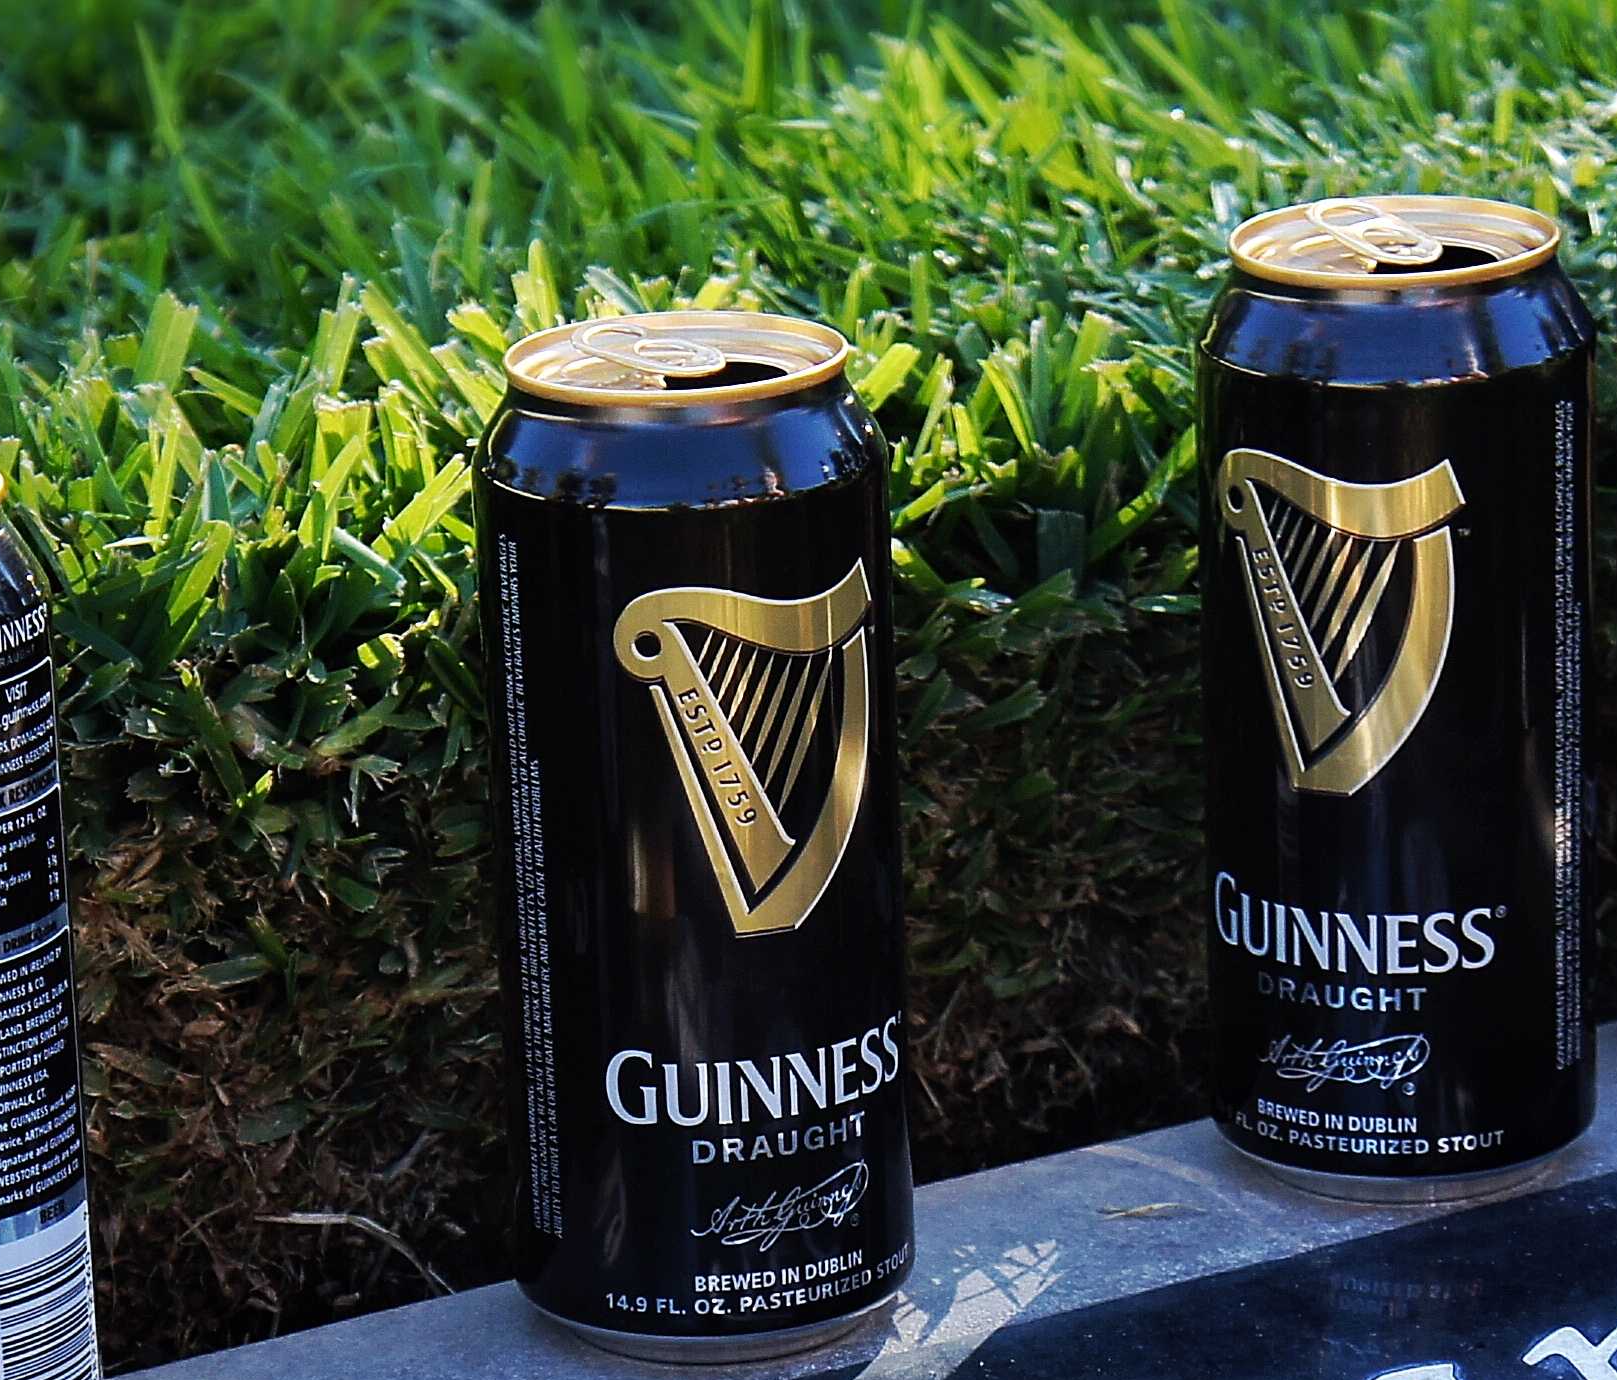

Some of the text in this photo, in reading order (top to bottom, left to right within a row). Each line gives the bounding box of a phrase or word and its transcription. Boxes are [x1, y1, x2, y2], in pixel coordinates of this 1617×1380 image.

[5, 681, 28, 703] VISIT
[713, 760, 757, 825] 1759
[16, 815, 25, 829] 12
[1215, 871, 1495, 975] GUINNESS
[1258, 971, 1427, 1012] DRAUGHT
[606, 1016, 901, 1126] GUINNESS
[10, 1104, 49, 1129] GUINNESS
[1257, 1098, 1417, 1134] BREWED IN DUBLIN
[35, 1141, 48, 1156] and
[692, 1111, 865, 1165] DRAUGHT
[1288, 1128, 1430, 1155] PASTEURIZED
[1437, 1129, 1505, 1154] STOUT
[606, 1242, 910, 1316] 14.9 FL. OZ. PASTEURIZED STOUT
[694, 1249, 864, 1293] BREWED IN DUBLIN
